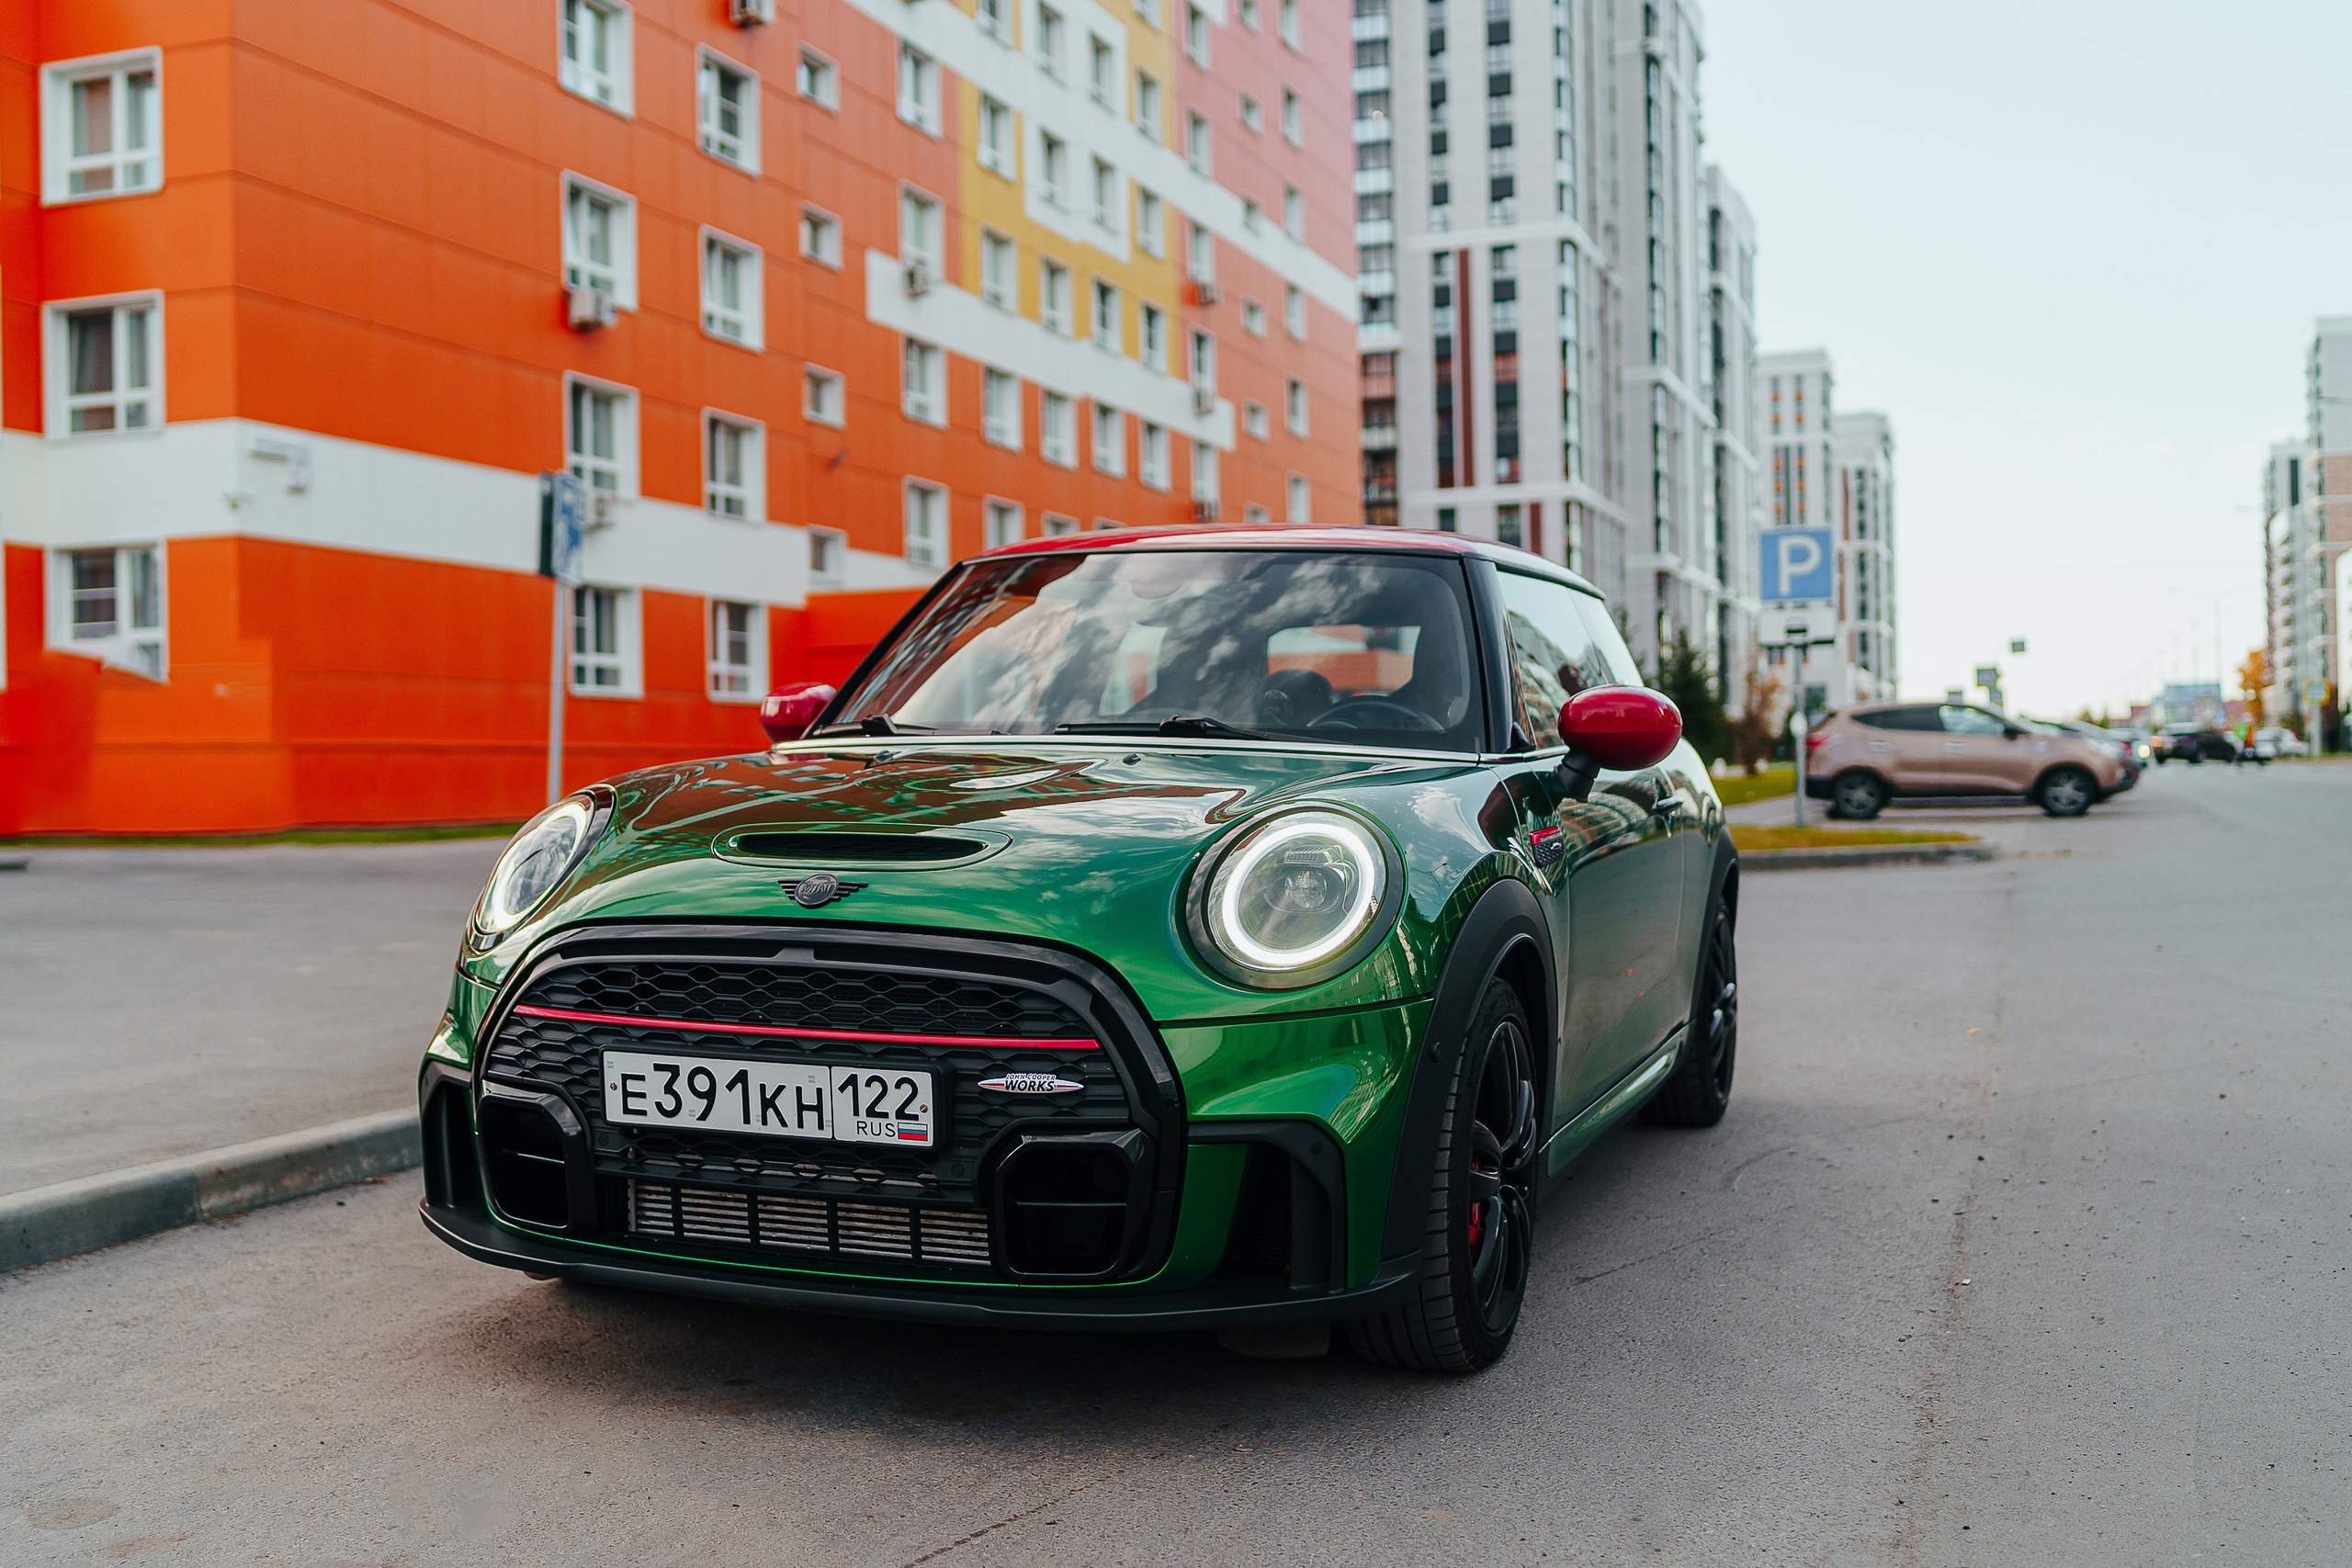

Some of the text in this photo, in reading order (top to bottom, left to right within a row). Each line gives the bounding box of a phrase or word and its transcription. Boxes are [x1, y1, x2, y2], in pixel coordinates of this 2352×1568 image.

[1779, 534, 1821, 596] P
[620, 1062, 920, 1131] E391KH 122
[1004, 1080, 1055, 1091] WORKS
[856, 1120, 897, 1138] RUS
